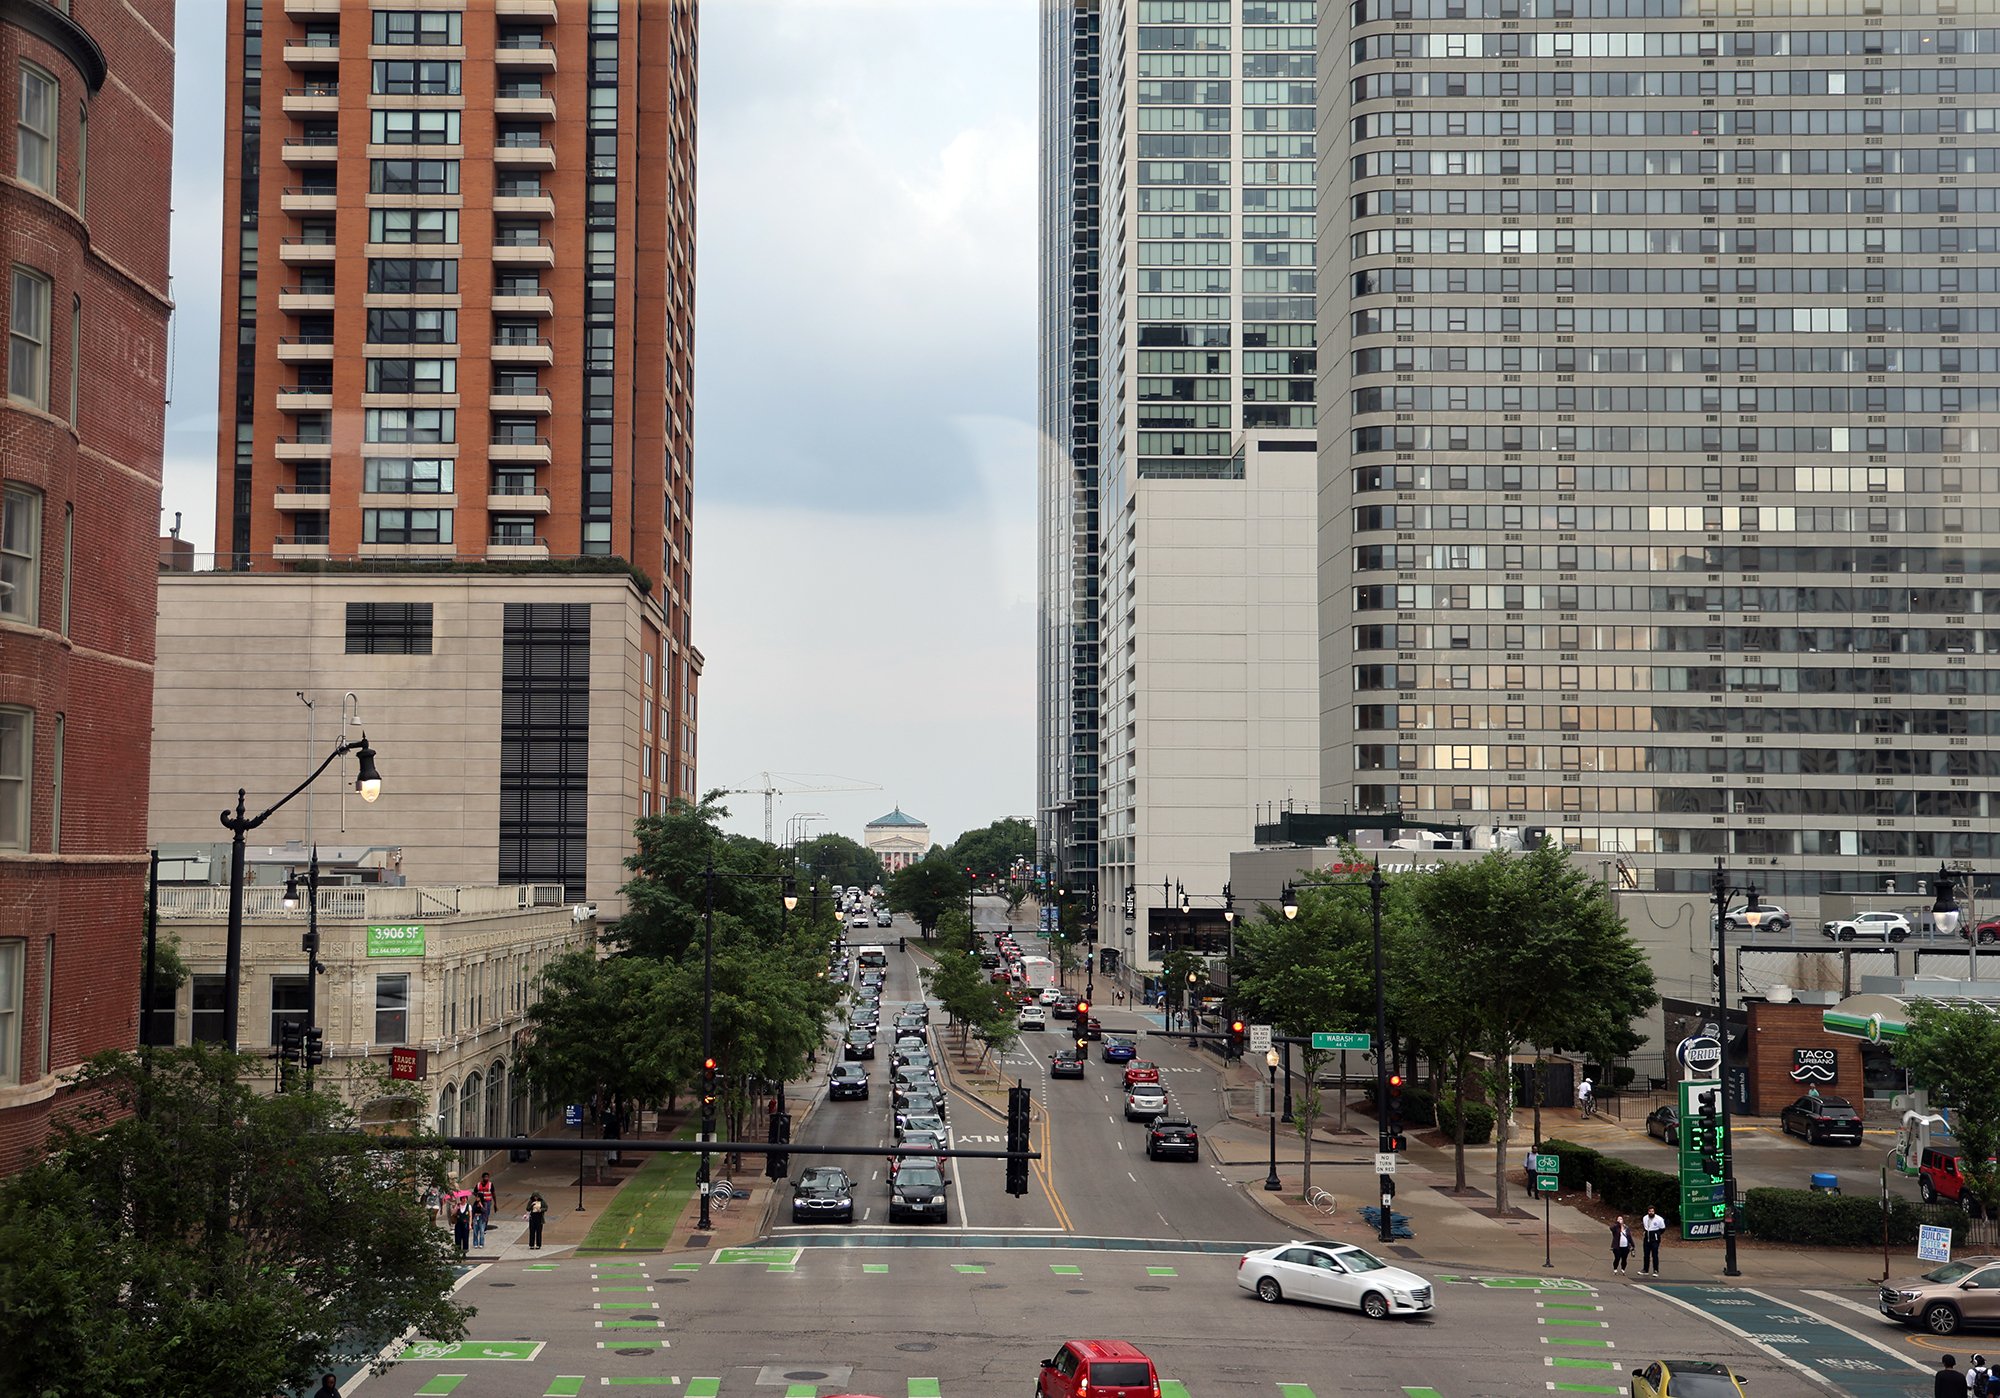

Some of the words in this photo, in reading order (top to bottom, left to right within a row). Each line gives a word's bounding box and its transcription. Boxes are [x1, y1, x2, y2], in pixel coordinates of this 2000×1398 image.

[1126, 890, 1134, 914] NEM
[375, 927, 404, 940] 3,906
[406, 926, 418, 938] SF
[1690, 1048, 1720, 1060] PRIDE
[1798, 1050, 1834, 1058] TACO
[394, 1055, 416, 1064] TRADER
[397, 1064, 412, 1072] JOE'S
[1690, 1225, 1708, 1235] CAR
[1710, 1222, 1724, 1234] WAS
[1922, 1231, 1941, 1240] BUILD
[1921, 1240, 1940, 1248] BETTER
[1920, 1247, 1948, 1256] TOGETHER
